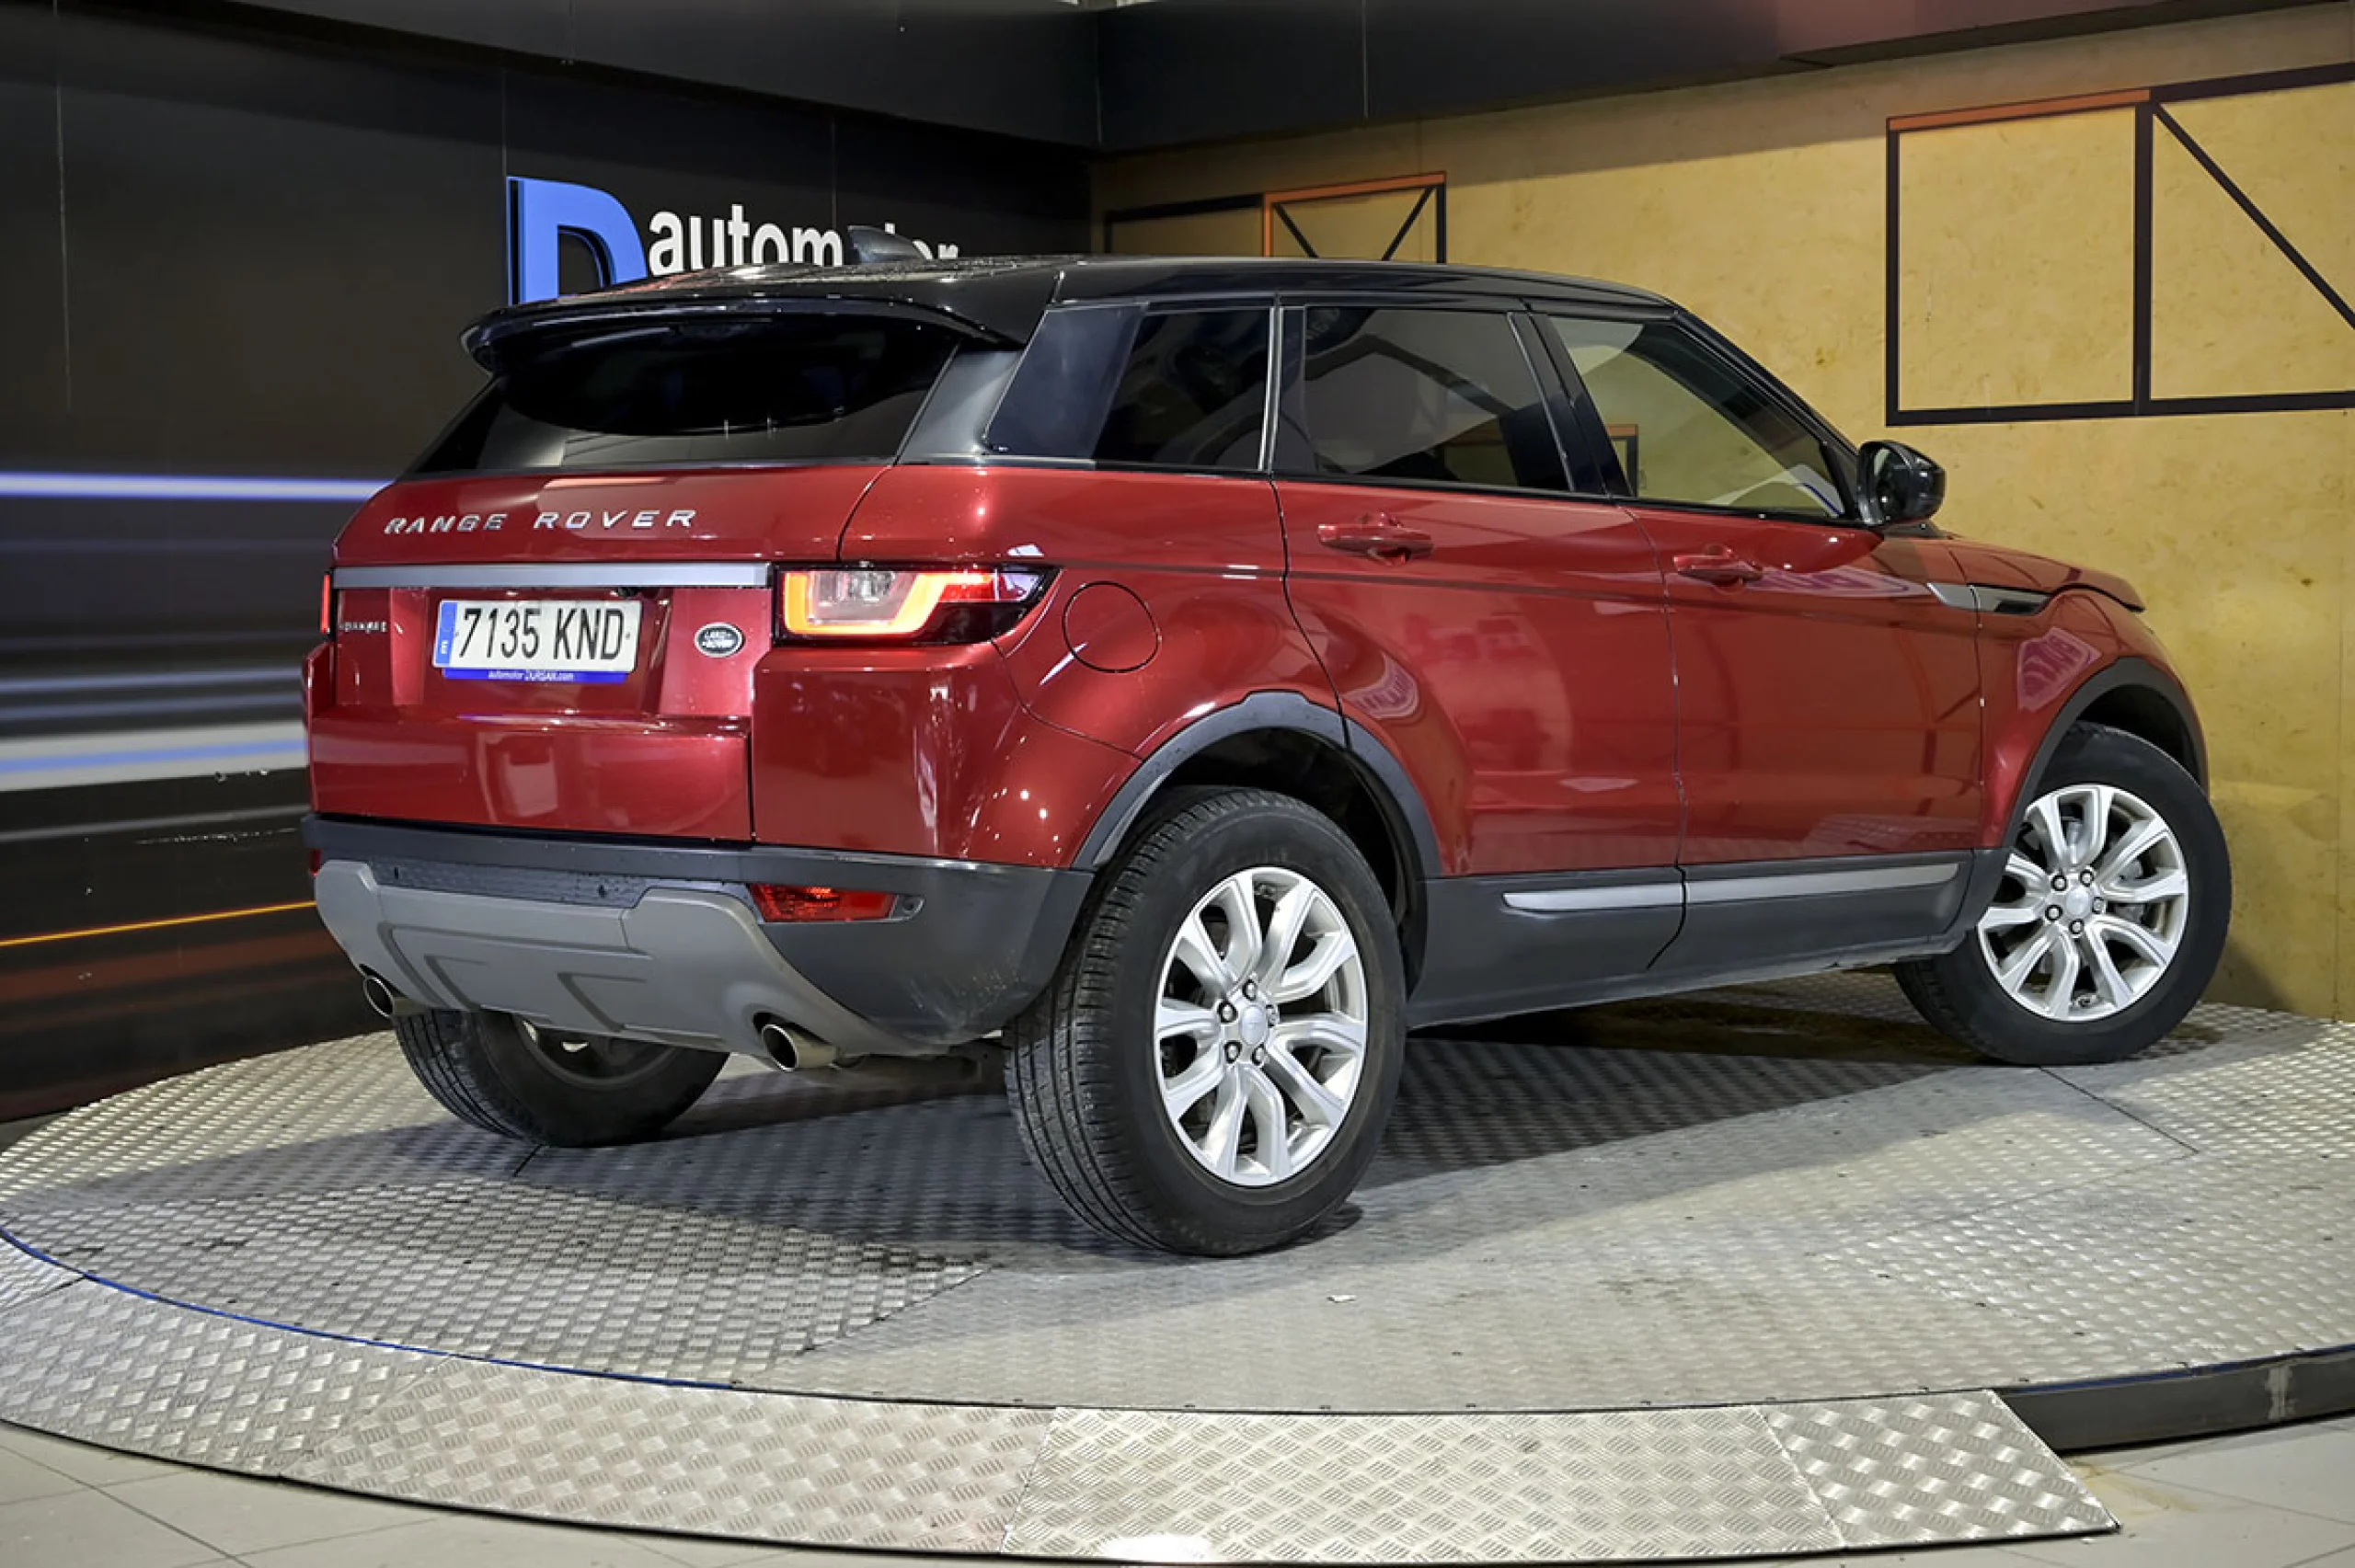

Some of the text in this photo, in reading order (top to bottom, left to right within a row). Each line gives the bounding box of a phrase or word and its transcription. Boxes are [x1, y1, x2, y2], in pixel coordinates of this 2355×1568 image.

[648, 203, 959, 277] autom
[384, 509, 696, 534] RANGE ROVER
[459, 607, 625, 660] 7135 KND
